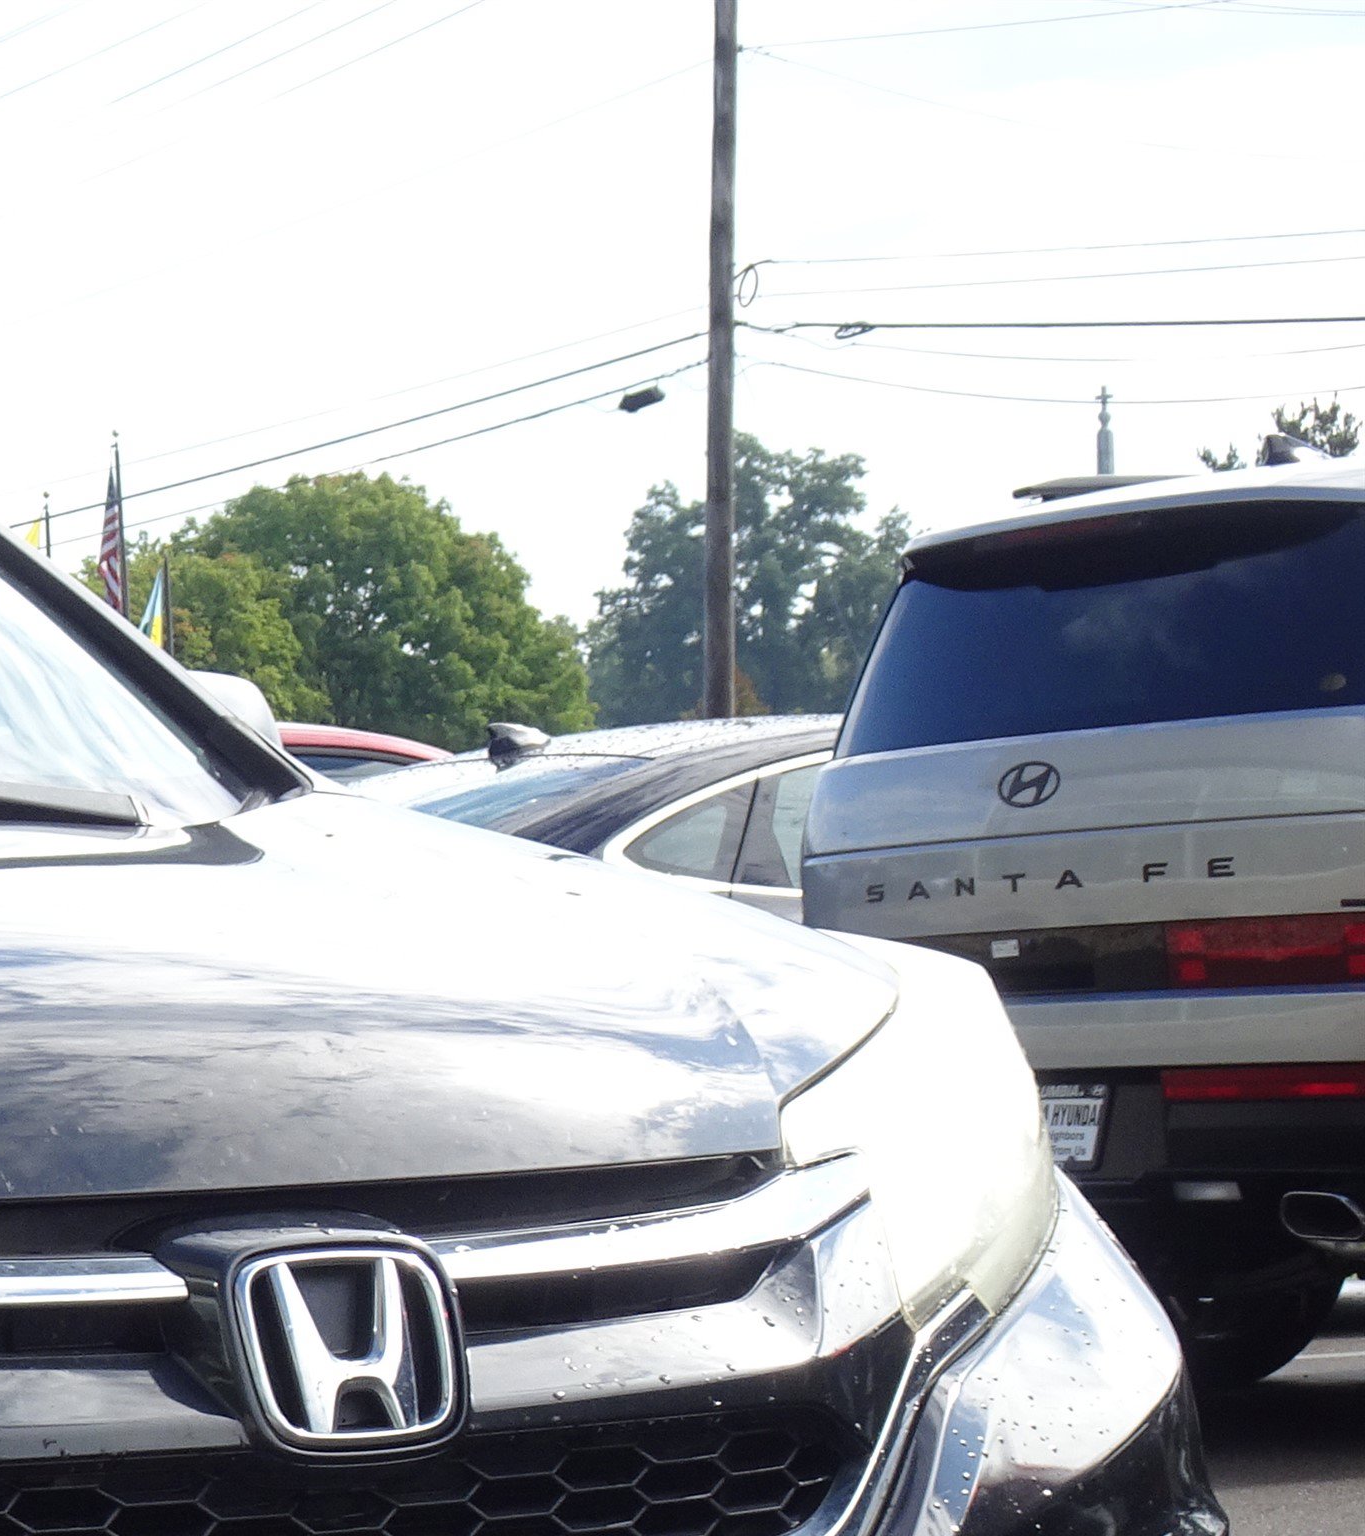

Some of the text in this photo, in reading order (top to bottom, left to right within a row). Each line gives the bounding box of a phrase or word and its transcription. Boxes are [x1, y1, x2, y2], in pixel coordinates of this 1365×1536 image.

[866, 856, 1236, 903] SANTA FE
[1050, 1104, 1099, 1126] HYUNDA
[1050, 1131, 1085, 1142] ighbors
